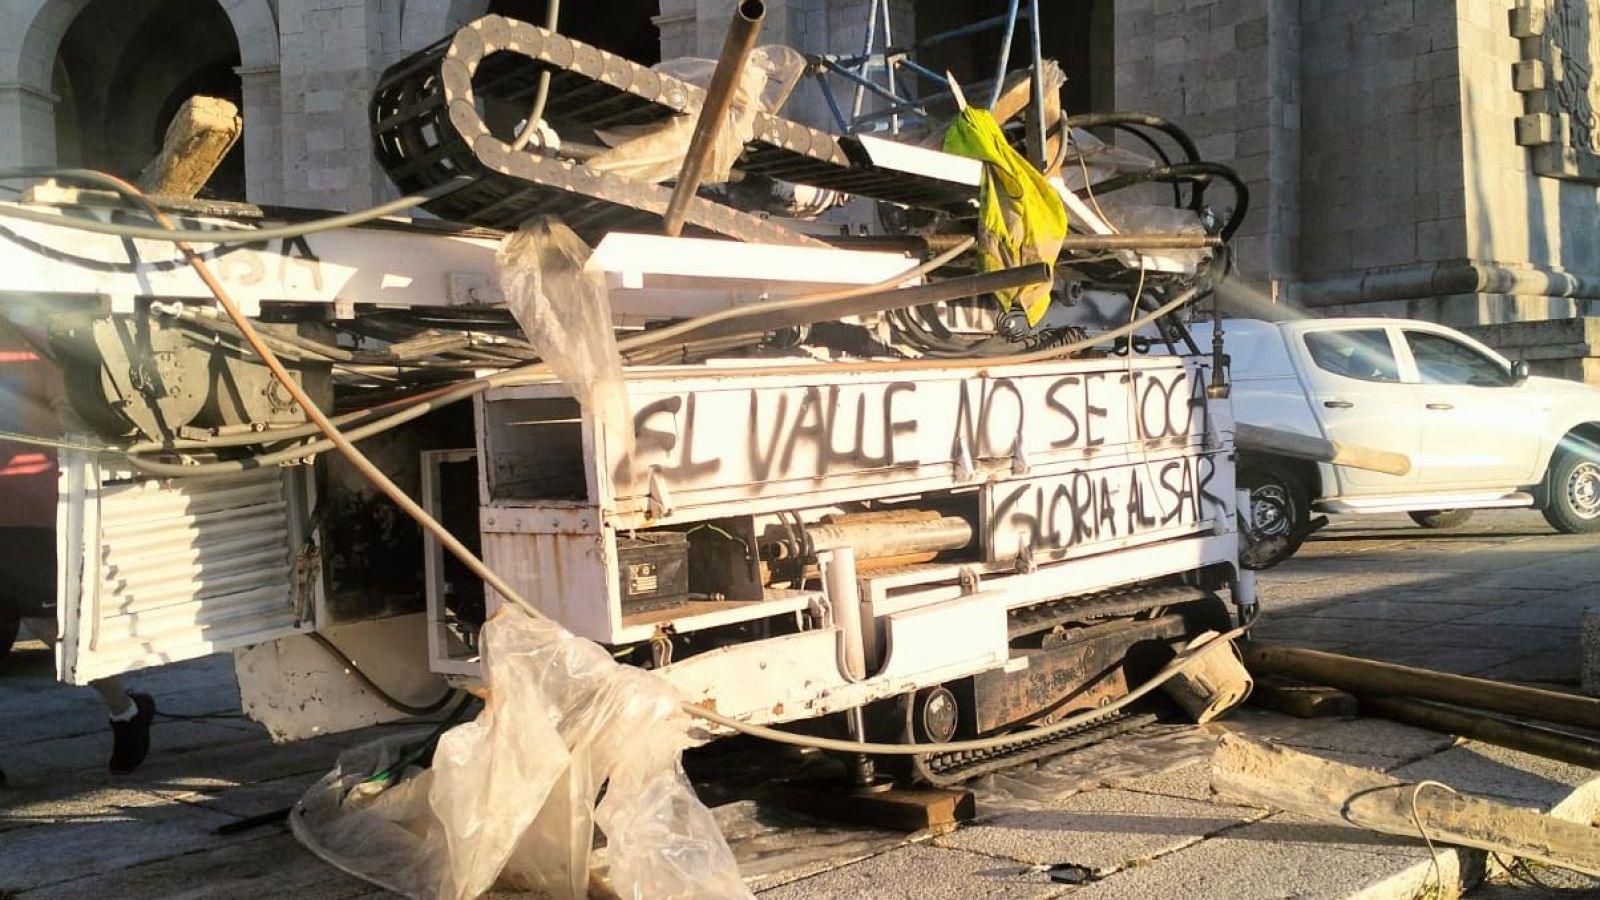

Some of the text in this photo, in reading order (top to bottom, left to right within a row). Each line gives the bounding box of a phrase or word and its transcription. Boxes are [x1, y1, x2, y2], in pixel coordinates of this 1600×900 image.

[613, 367, 1209, 489] EL VALLE NO SE TOCA
[988, 456, 1228, 557] GLORIA AL SAR
